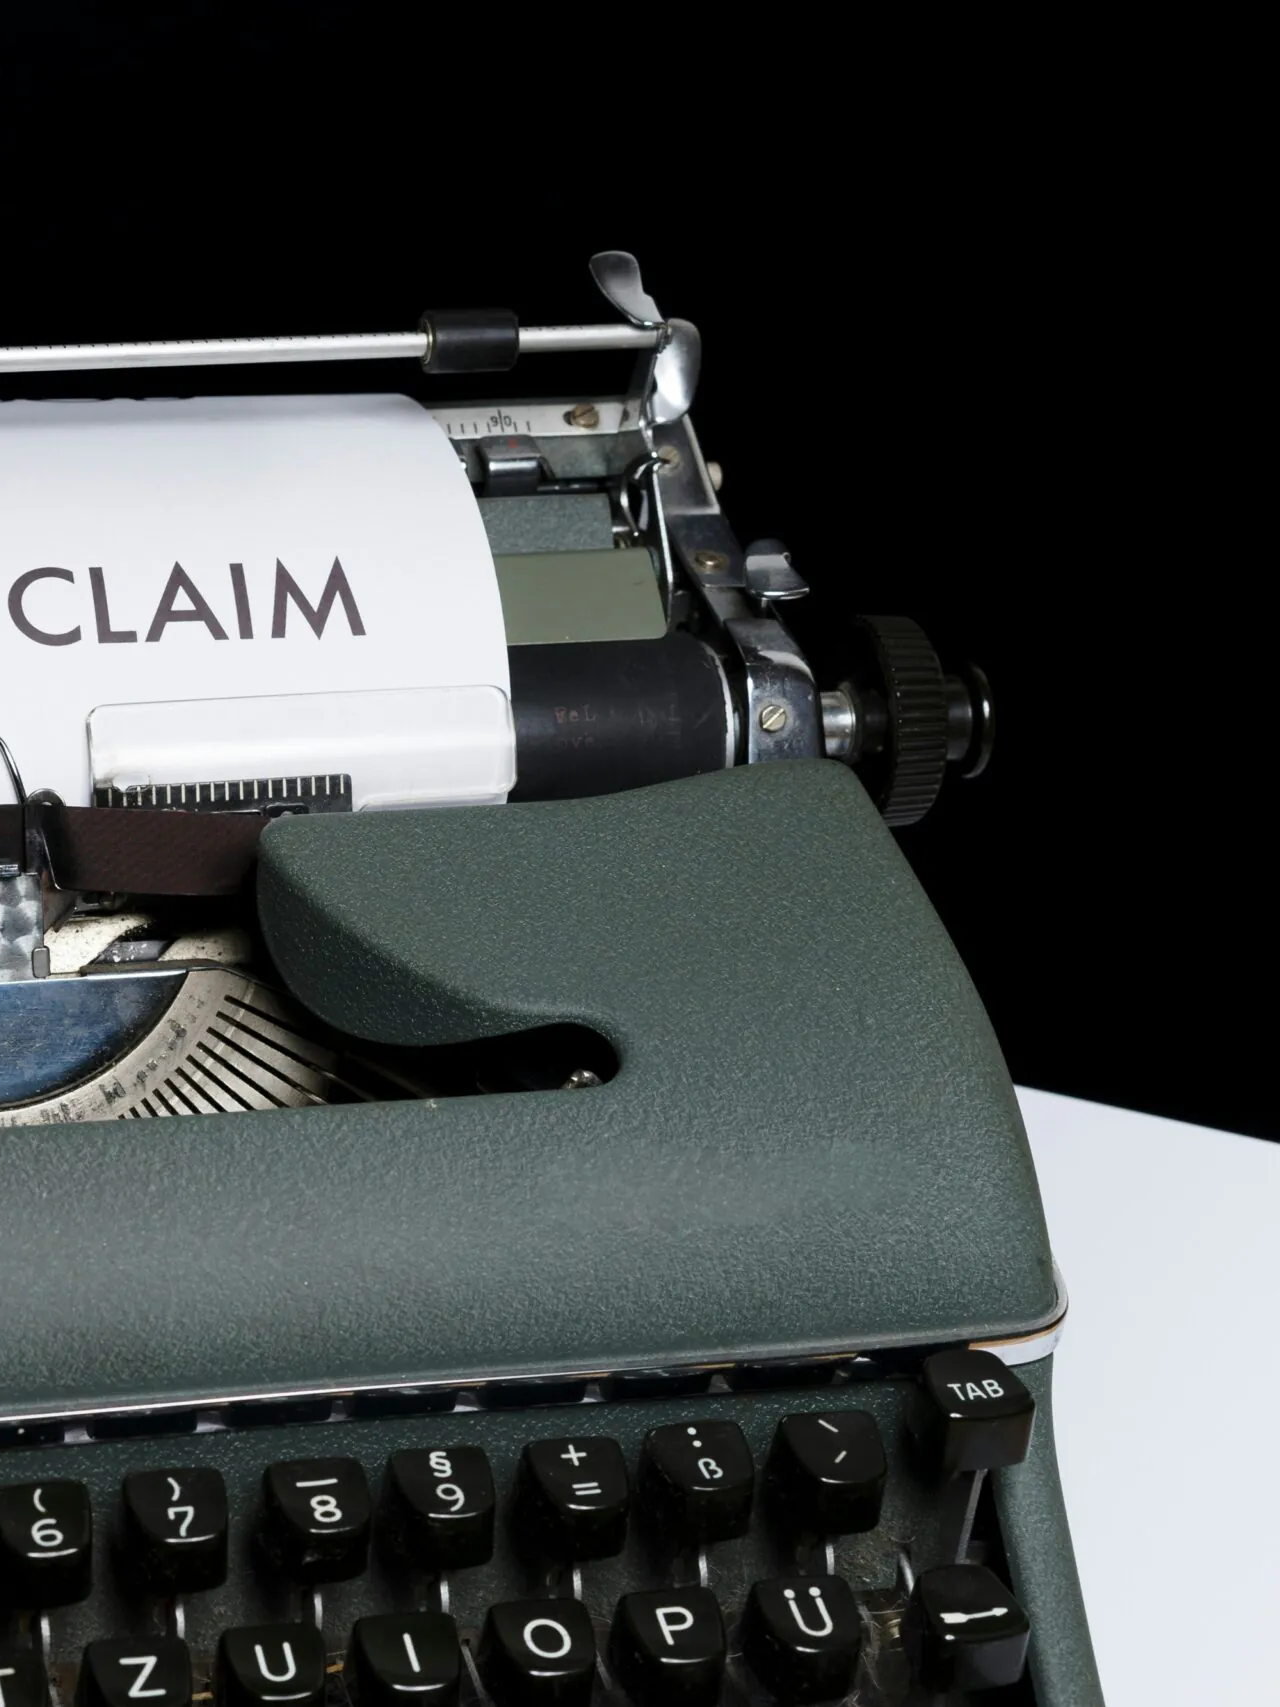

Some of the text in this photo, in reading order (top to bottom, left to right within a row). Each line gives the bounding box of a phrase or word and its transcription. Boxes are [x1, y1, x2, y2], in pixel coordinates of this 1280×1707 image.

[7, 556, 366, 647] CLAIM
[947, 1378, 1006, 1402] TAB
[428, 1450, 453, 1478] §
[560, 1443, 587, 1466] +
[32, 1487, 46, 1513] (
[166, 1476, 181, 1502] )
[435, 1483, 465, 1512] 9
[571, 1481, 603, 1496] =
[166, 1505, 195, 1537] 7
[309, 1495, 343, 1523] 8
[30, 1517, 64, 1548] 6
[654, 1605, 695, 1646] P
[782, 1585, 834, 1638] Ü
[402, 1632, 422, 1674] I
[522, 1617, 573, 1659] O
[118, 1654, 167, 1699] Z
[253, 1641, 297, 1683] U
